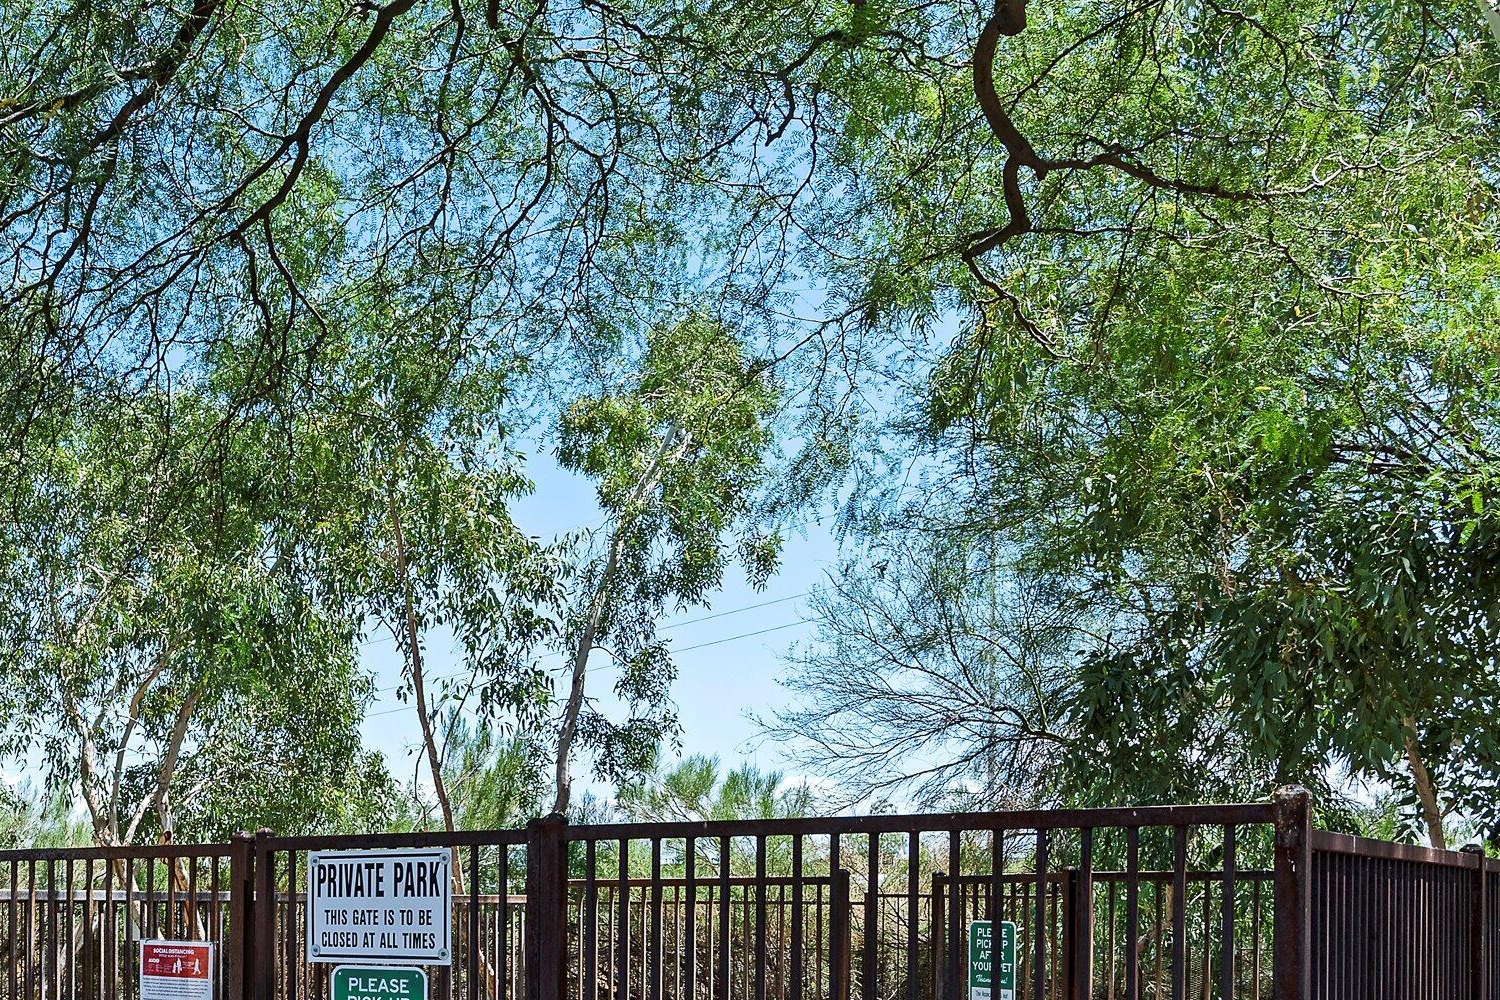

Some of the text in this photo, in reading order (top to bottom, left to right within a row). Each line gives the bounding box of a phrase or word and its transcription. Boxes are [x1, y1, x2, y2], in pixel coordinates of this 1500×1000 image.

[317, 861, 441, 898] PRIVATE PARK
[324, 909, 432, 926] THIS GATE IS TO BE
[321, 931, 435, 950] CLOSED AT ALL TIMES
[977, 927, 1008, 938] PLEE
[979, 950, 1005, 961] AFR
[348, 977, 410, 994] PLEASE
